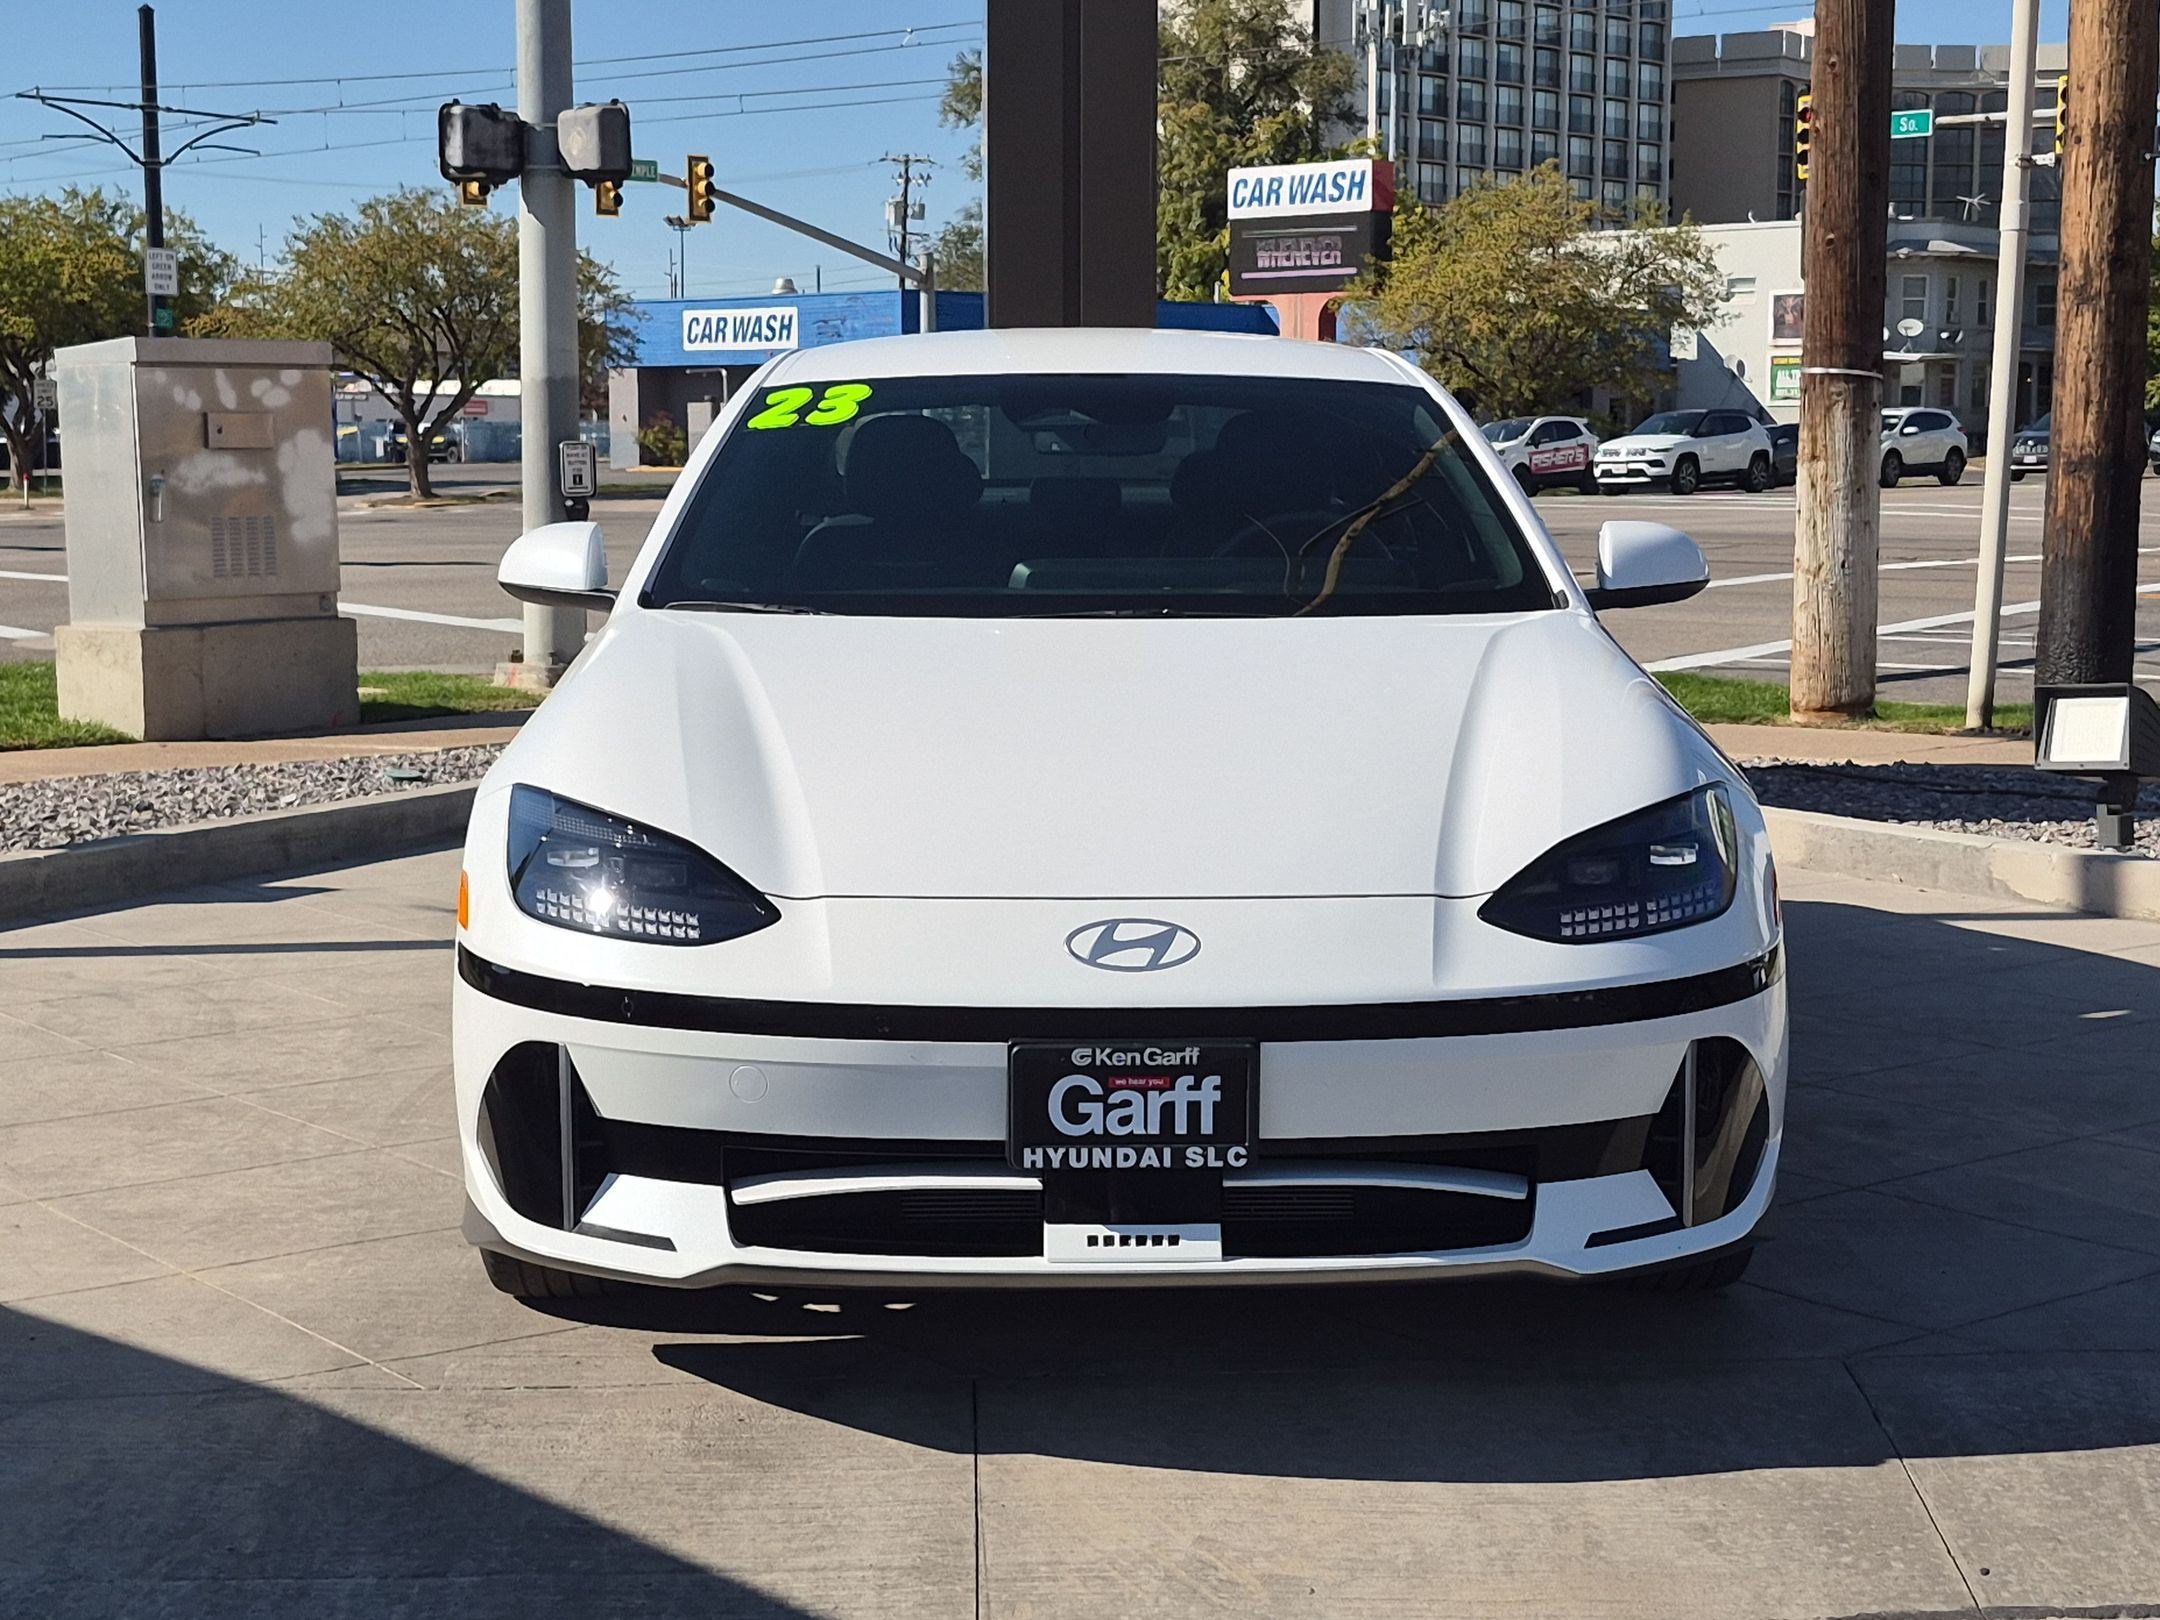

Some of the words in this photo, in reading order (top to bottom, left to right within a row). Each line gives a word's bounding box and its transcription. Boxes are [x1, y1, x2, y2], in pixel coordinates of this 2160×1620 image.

[1898, 116, 1918, 132] So.
[1232, 176, 1284, 209] CAR
[1288, 169, 1367, 206] WASH
[687, 316, 728, 344] CAR
[732, 313, 794, 343] WASH
[37, 395, 54, 407] 25
[746, 383, 873, 430] 23
[1095, 1047, 1142, 1067] Ken
[1143, 1046, 1200, 1067] Garff
[1047, 1074, 1222, 1137] Garff
[1023, 1146, 1171, 1169] HYUNDAI
[1185, 1146, 1248, 1168] SLC
